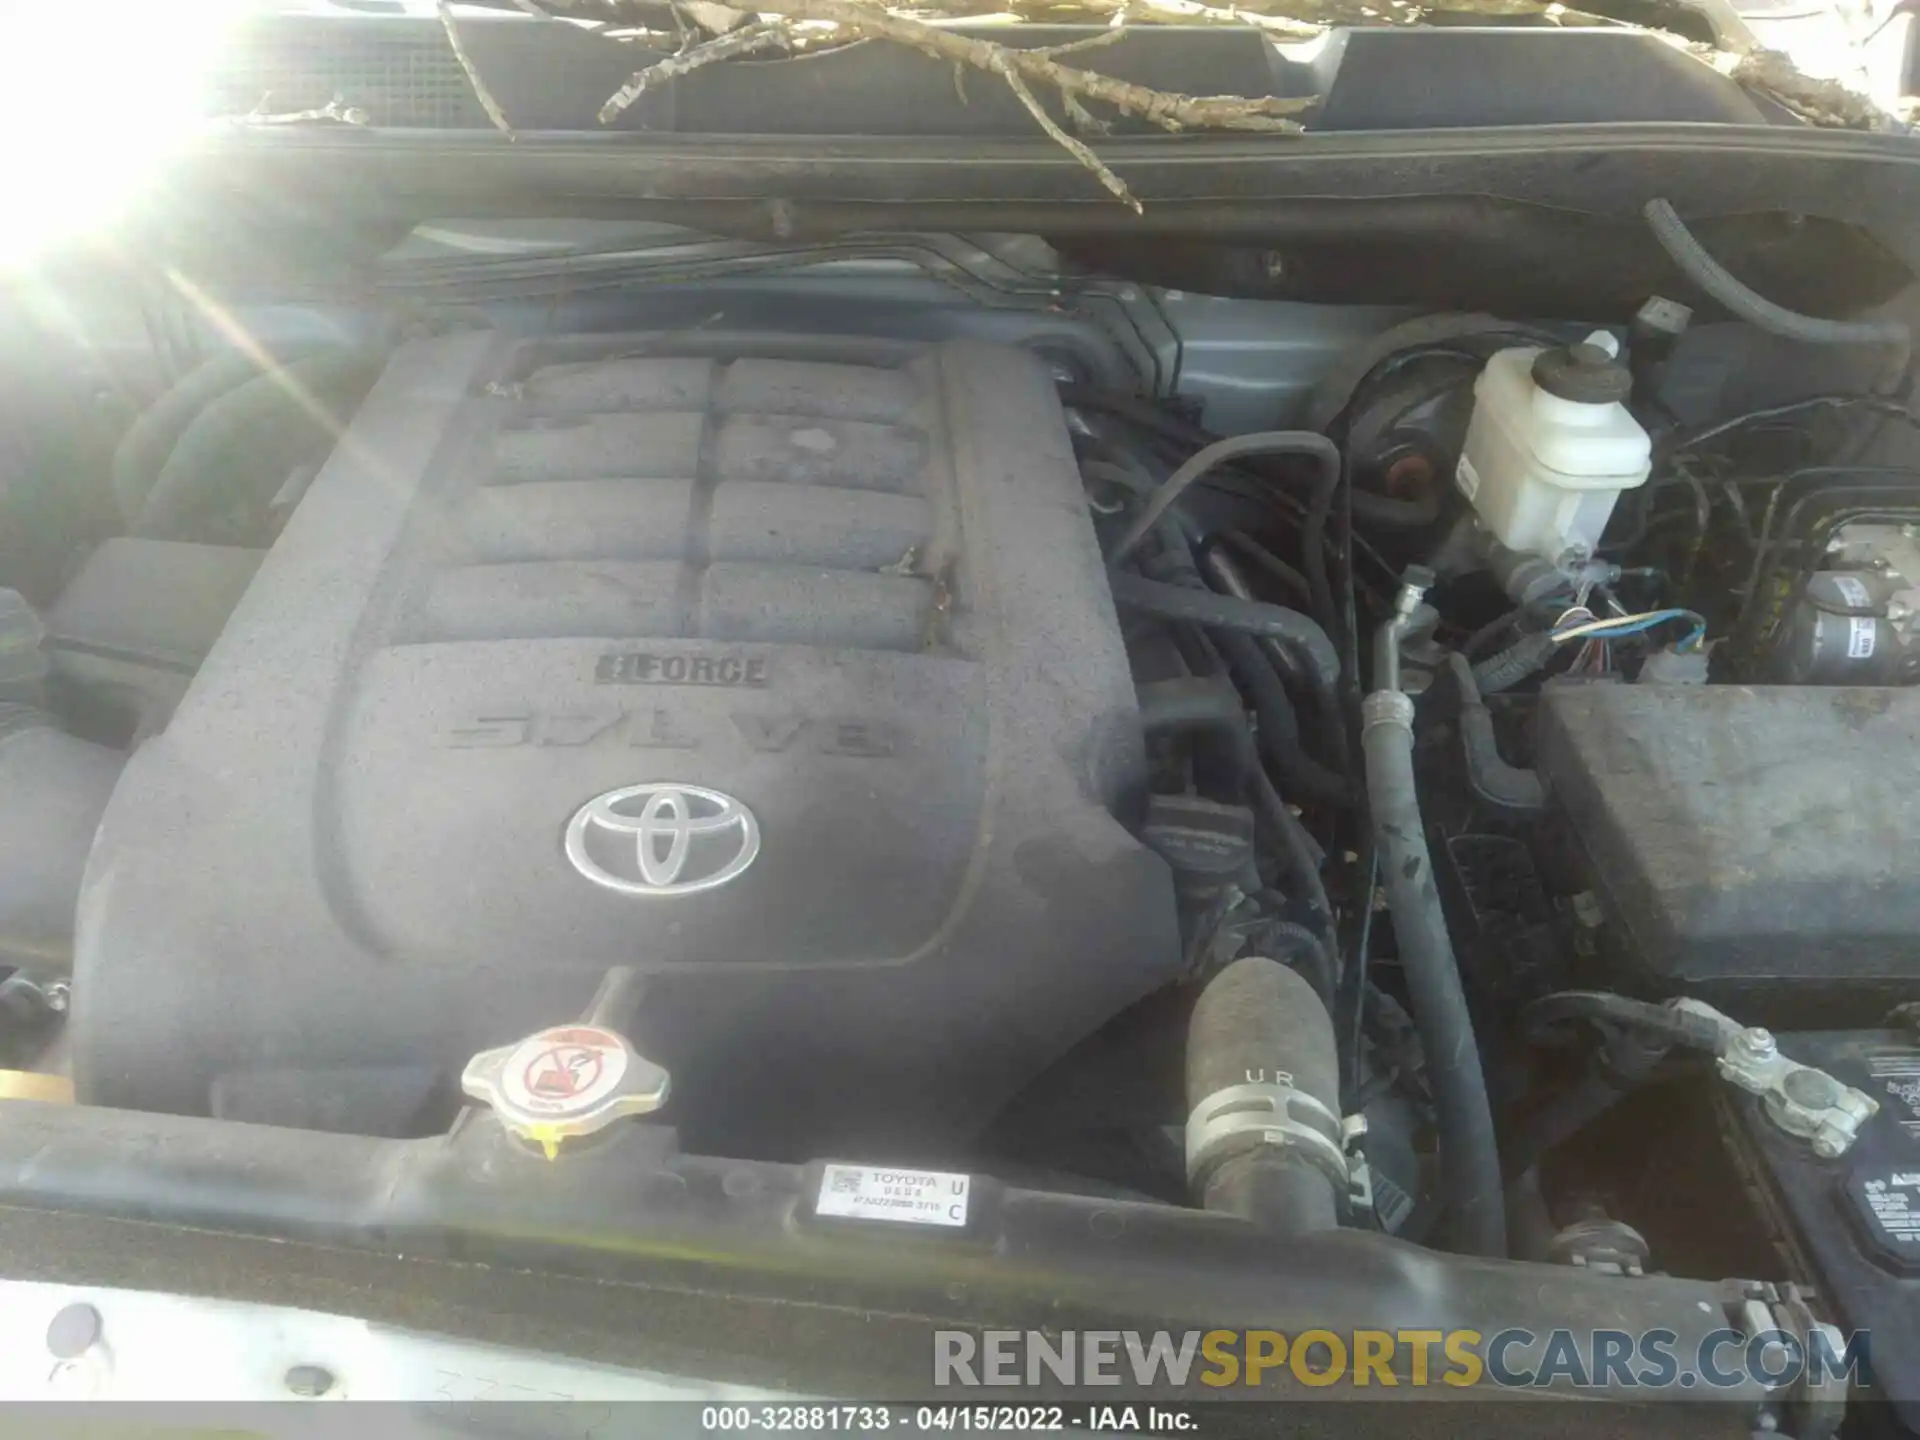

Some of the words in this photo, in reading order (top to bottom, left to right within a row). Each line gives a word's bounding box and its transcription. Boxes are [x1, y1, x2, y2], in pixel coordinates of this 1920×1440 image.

[873, 1173, 937, 1188] TOYOTA
[952, 1180, 964, 1196] U
[949, 1204, 962, 1220] C
